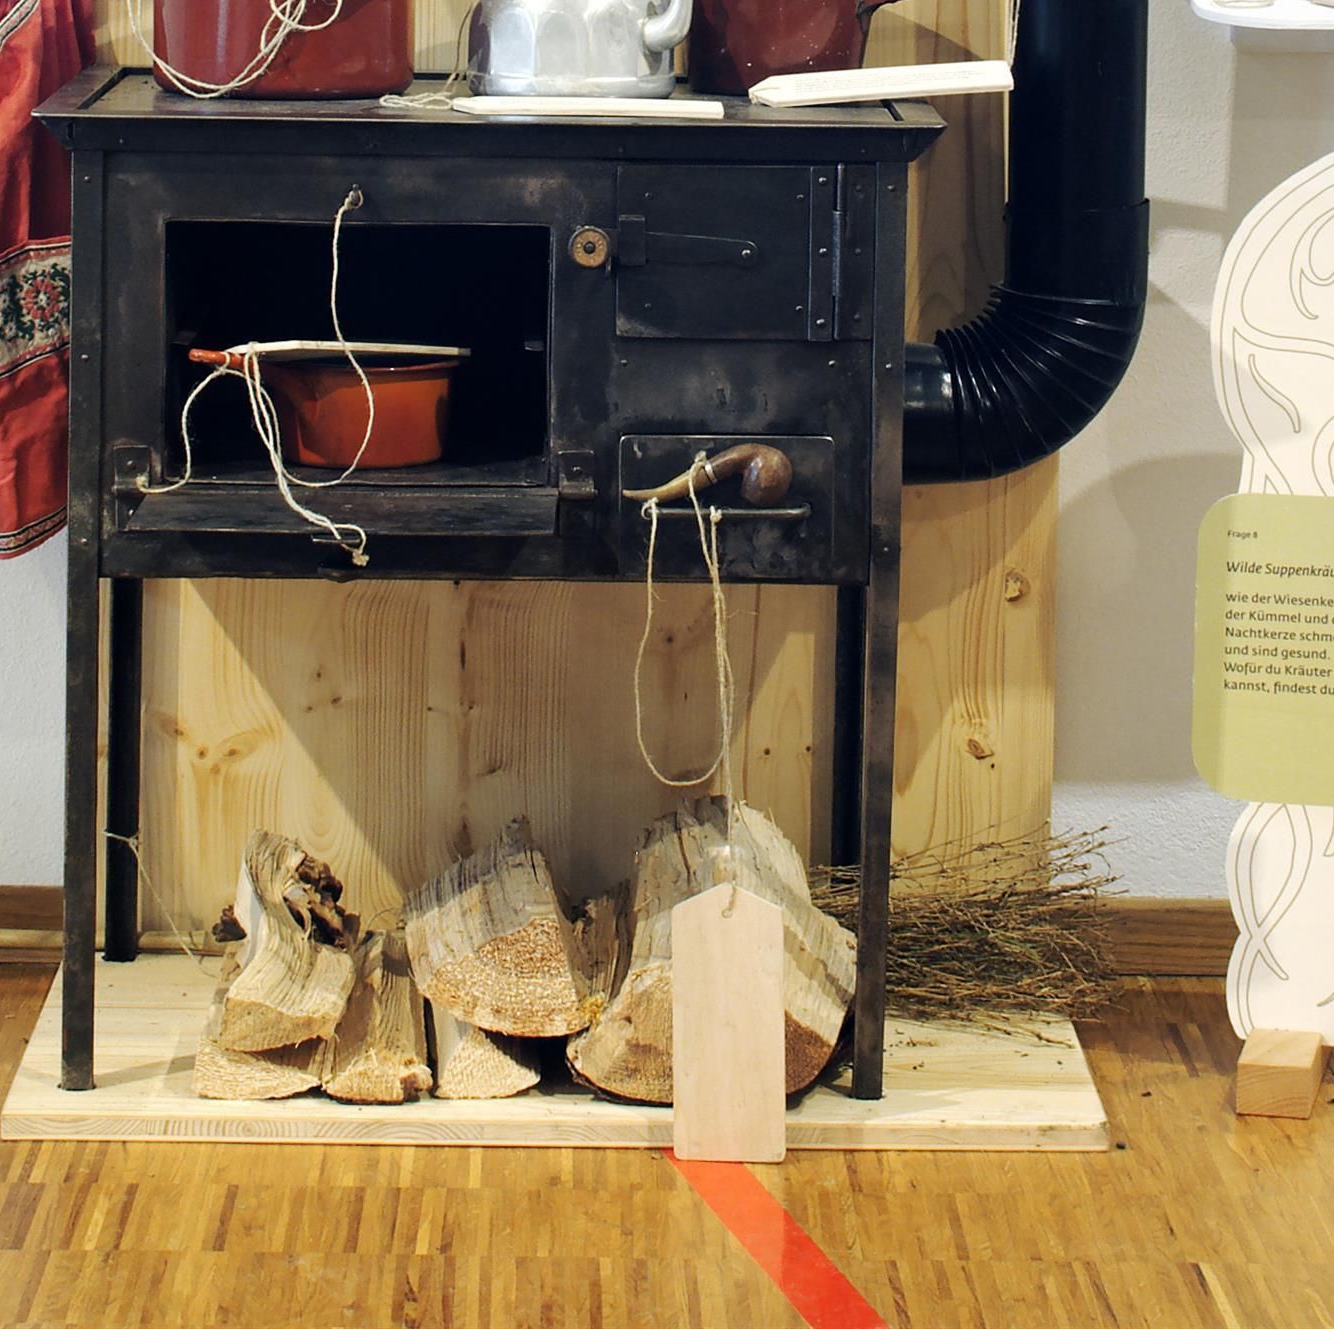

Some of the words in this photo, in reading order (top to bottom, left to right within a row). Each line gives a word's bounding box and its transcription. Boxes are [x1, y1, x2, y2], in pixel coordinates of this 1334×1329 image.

[1226, 560, 1262, 574] Wilde
[1225, 593, 1248, 602] wie
[1251, 592, 1272, 604] der
[1224, 608, 1245, 620] der
[1248, 610, 1301, 623] Kümmel
[1304, 613, 1328, 624] und
[1224, 626, 1296, 640] Nachtkerze
[1224, 644, 1249, 655] und
[1251, 645, 1278, 657] sind
[1280, 648, 1330, 660] gesund.
[1223, 661, 1262, 675] Wofür
[1265, 663, 1281, 675] du
[1284, 664, 1333, 677] Kräuter
[1223, 678, 1270, 693] kannst,
[1273, 681, 1317, 694] findest
[1319, 684, 1334, 695] du
